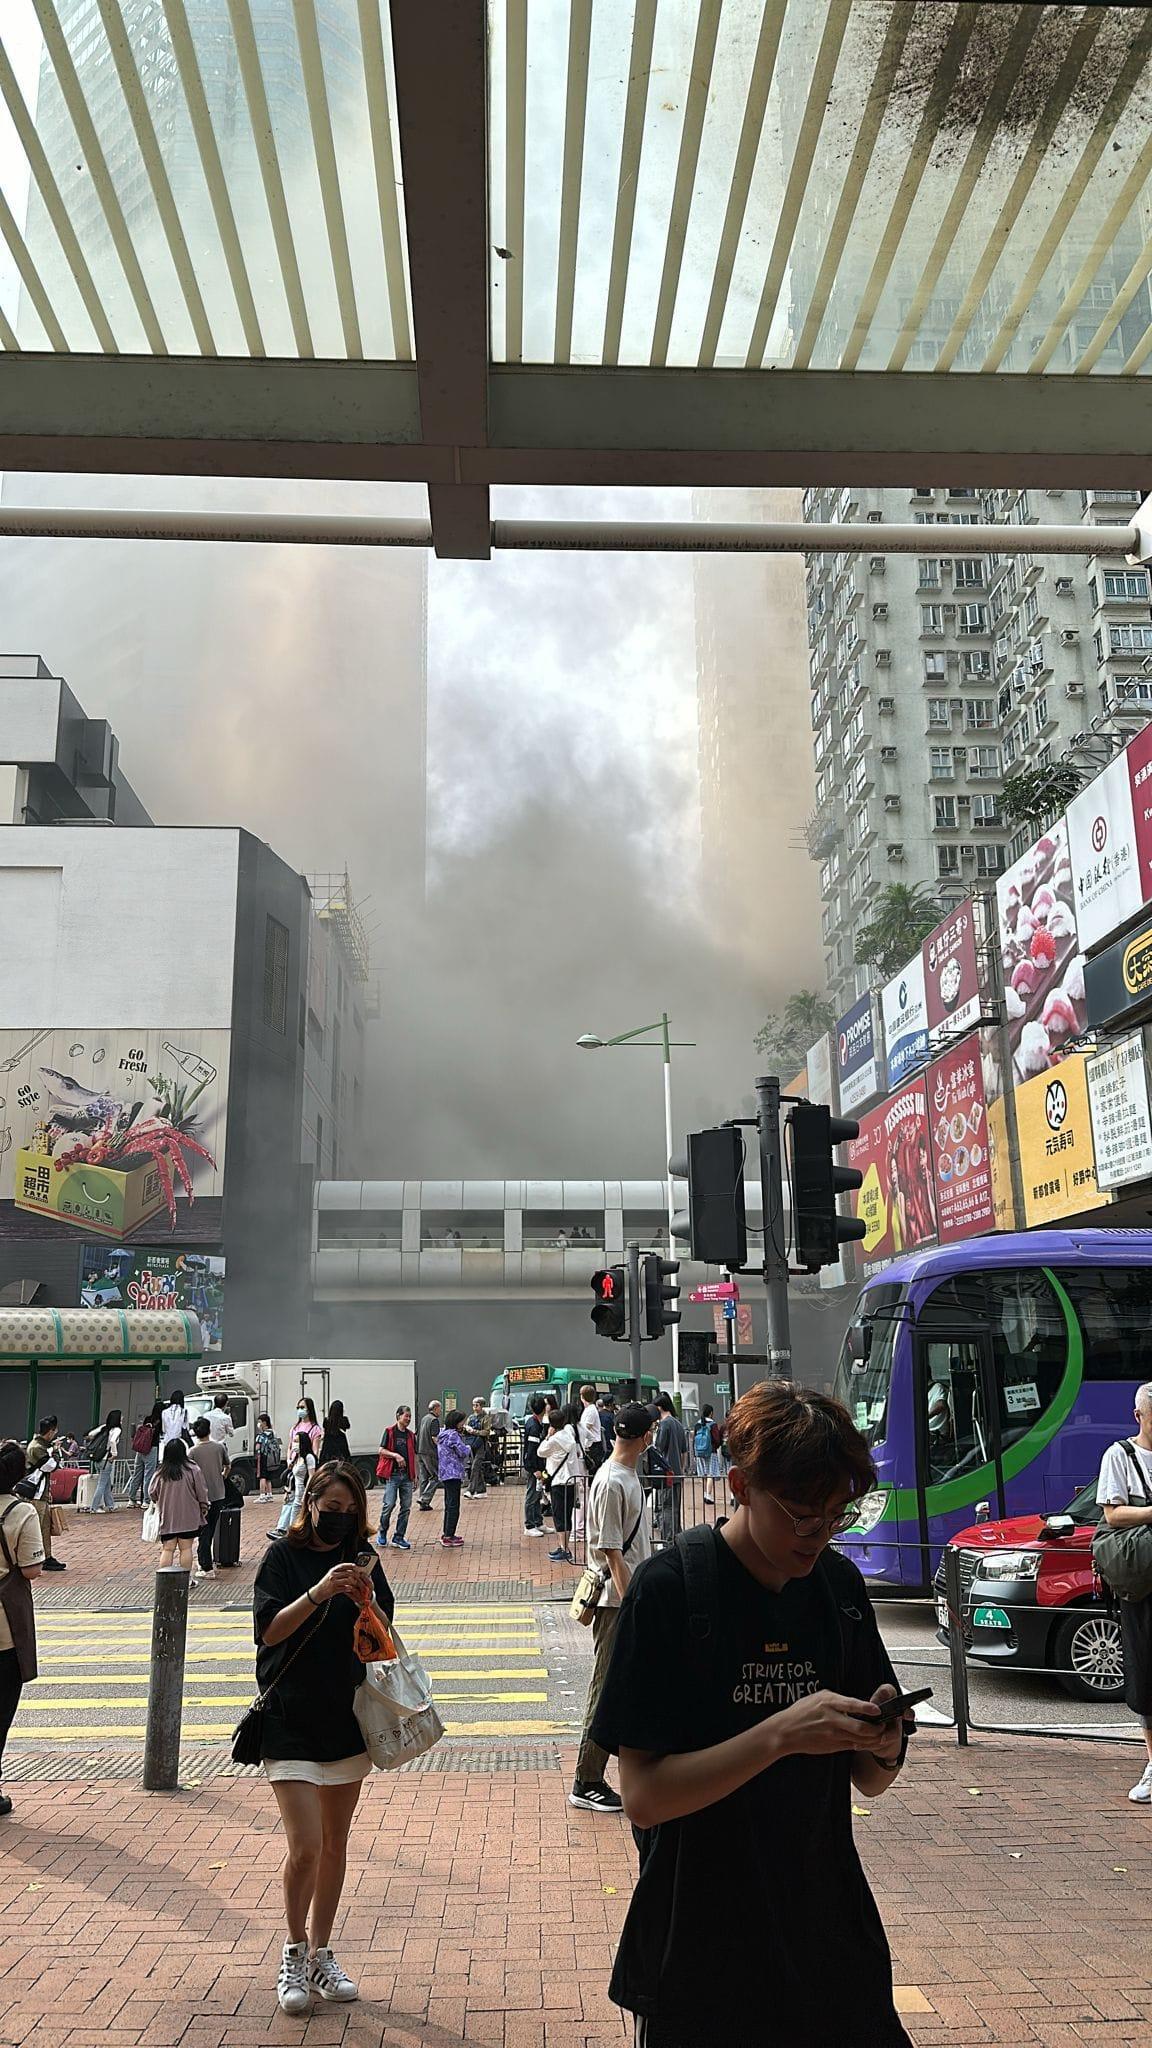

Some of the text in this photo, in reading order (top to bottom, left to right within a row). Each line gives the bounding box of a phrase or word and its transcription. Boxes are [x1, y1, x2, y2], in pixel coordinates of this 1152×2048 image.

[846, 1010, 871, 1045] PROMISE
[128, 1049, 144, 1060] GO
[118, 1060, 148, 1073] Fresh
[17, 1084, 32, 1097] GO
[18, 1091, 41, 1108] Style
[141, 1271, 177, 1295] FUN
[128, 1281, 179, 1310] PARK
[1008, 1396, 1014, 1404] 3
[985, 1610, 993, 1620] 4
[742, 1661, 816, 1680] STRIVE FOR
